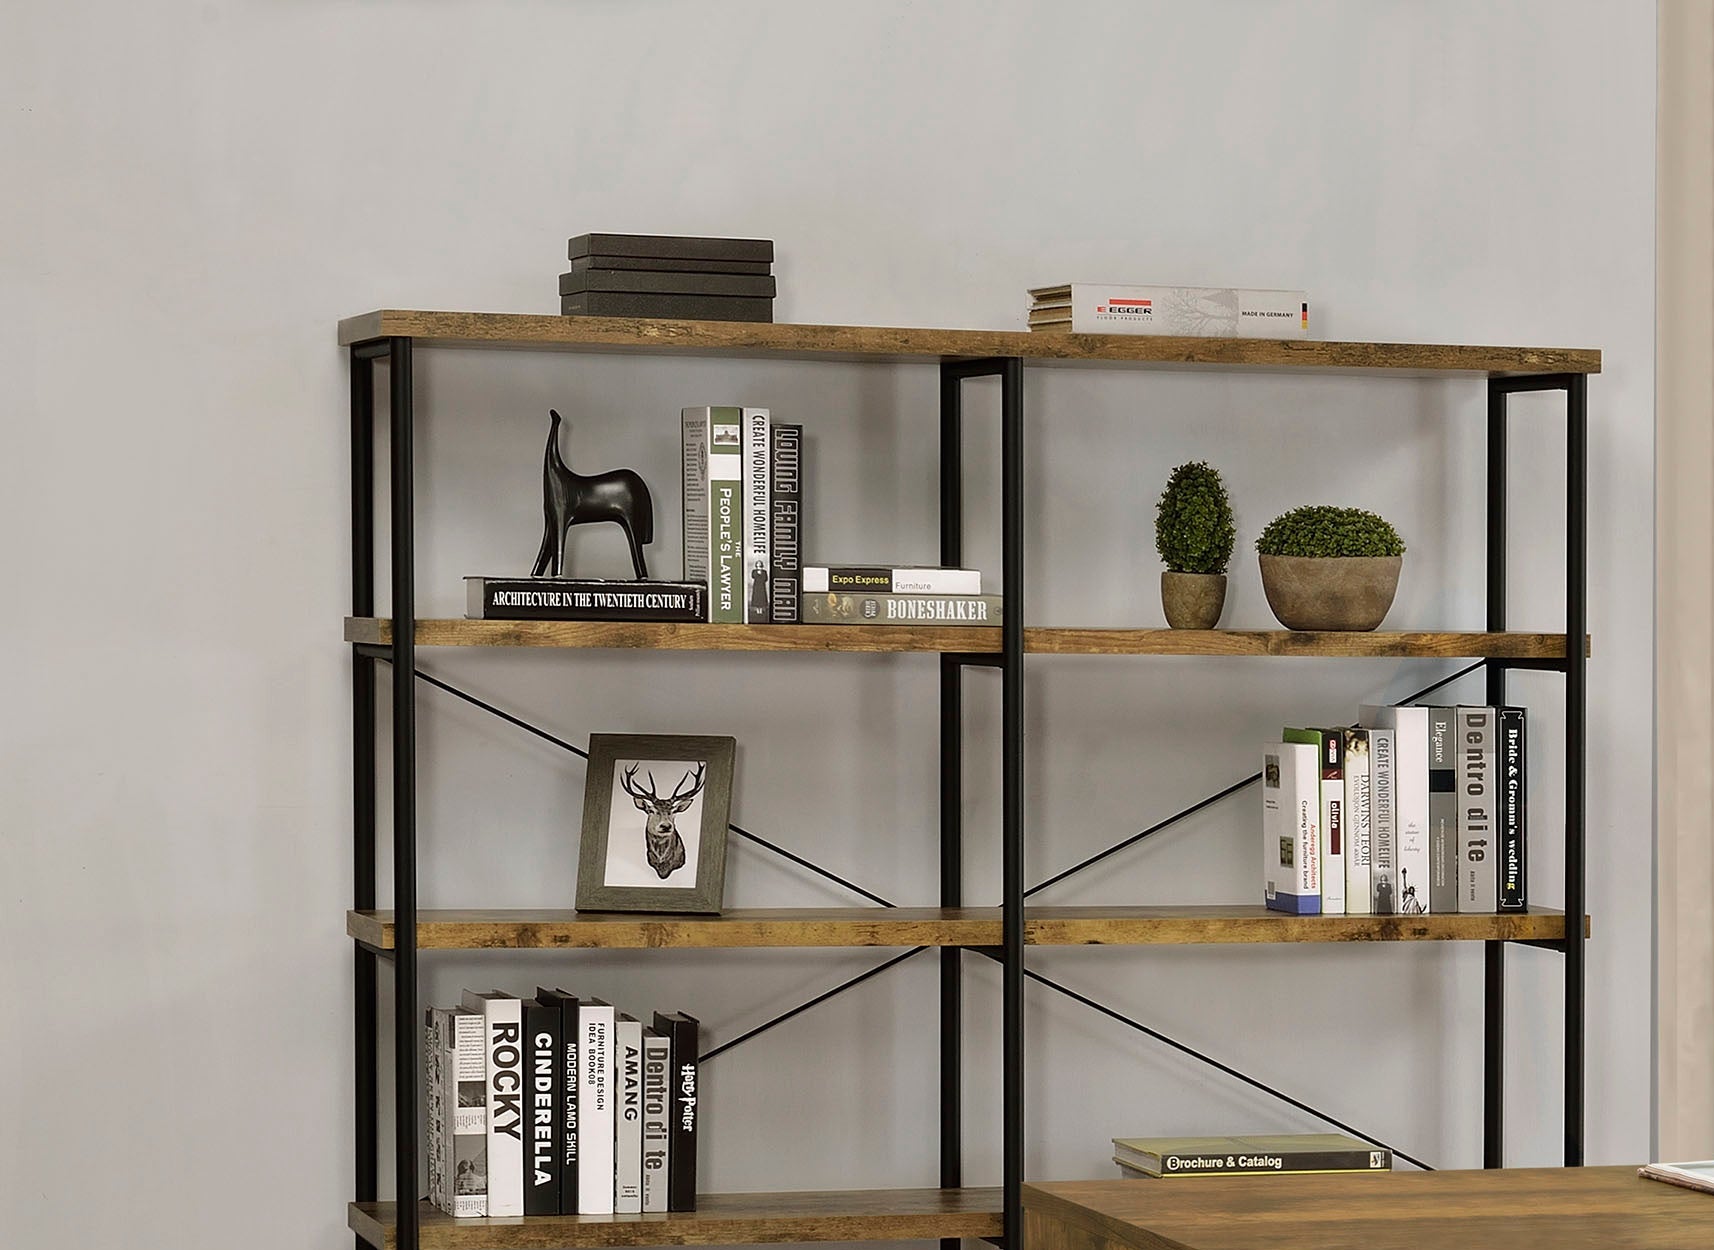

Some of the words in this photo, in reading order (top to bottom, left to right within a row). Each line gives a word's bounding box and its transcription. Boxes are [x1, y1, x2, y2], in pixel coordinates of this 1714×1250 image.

[1109, 306, 1152, 314] EGGER
[752, 415, 765, 448] CREATE
[752, 451, 766, 506] WONDERFUL
[719, 488, 732, 551] PEOPLE'S
[753, 509, 766, 554] HOMELIFE
[720, 555, 733, 611] LAWYER
[832, 575, 854, 585] Expo
[855, 575, 889, 585] Express
[895, 582, 932, 590] Furniture
[492, 591, 562, 606] ARCHITECYURE
[562, 592, 573, 607] IN
[573, 592, 592, 607] THE
[593, 593, 645, 608] TWENTIETH
[645, 594, 687, 609] CENTURY
[887, 600, 988, 620] BONESHAKER
[1377, 738, 1389, 768] CREATE
[1432, 722, 1447, 763] Elegance
[1466, 714, 1487, 796] Dentro
[1508, 729, 1518, 764] Bride
[1508, 766, 1518, 777] &
[1361, 774, 1371, 829] DARWINS
[1378, 771, 1390, 827] WONDERFUL
[1508, 779, 1518, 835] Gromm's
[1467, 808, 1489, 831] di
[1361, 832, 1371, 866] TEORI
[1378, 828, 1390, 869] HOMELIFE
[1468, 840, 1487, 862] te
[1507, 839, 1518, 890] wedding
[588, 1023, 596, 1044] IDEA
[597, 1023, 605, 1074] FURNITURE
[492, 1022, 521, 1141] ROCKY
[566, 1043, 577, 1092] MODERN
[588, 1049, 596, 1085] BOOK08
[624, 1046, 638, 1121] AMANG
[646, 1047, 668, 1115] Dentro
[680, 1063, 696, 1097] Harry
[534, 1032, 553, 1187] CINDERELLA
[597, 1075, 605, 1111] DESIGN
[566, 1095, 577, 1129] LAMO
[678, 1097, 697, 1132] Potter
[645, 1121, 667, 1140] di
[566, 1133, 577, 1165] SKILL
[645, 1150, 666, 1170] te
[1166, 1156, 1224, 1170] Brochure
[1226, 1156, 1236, 1168] &
[1238, 1155, 1282, 1169] Catalog
